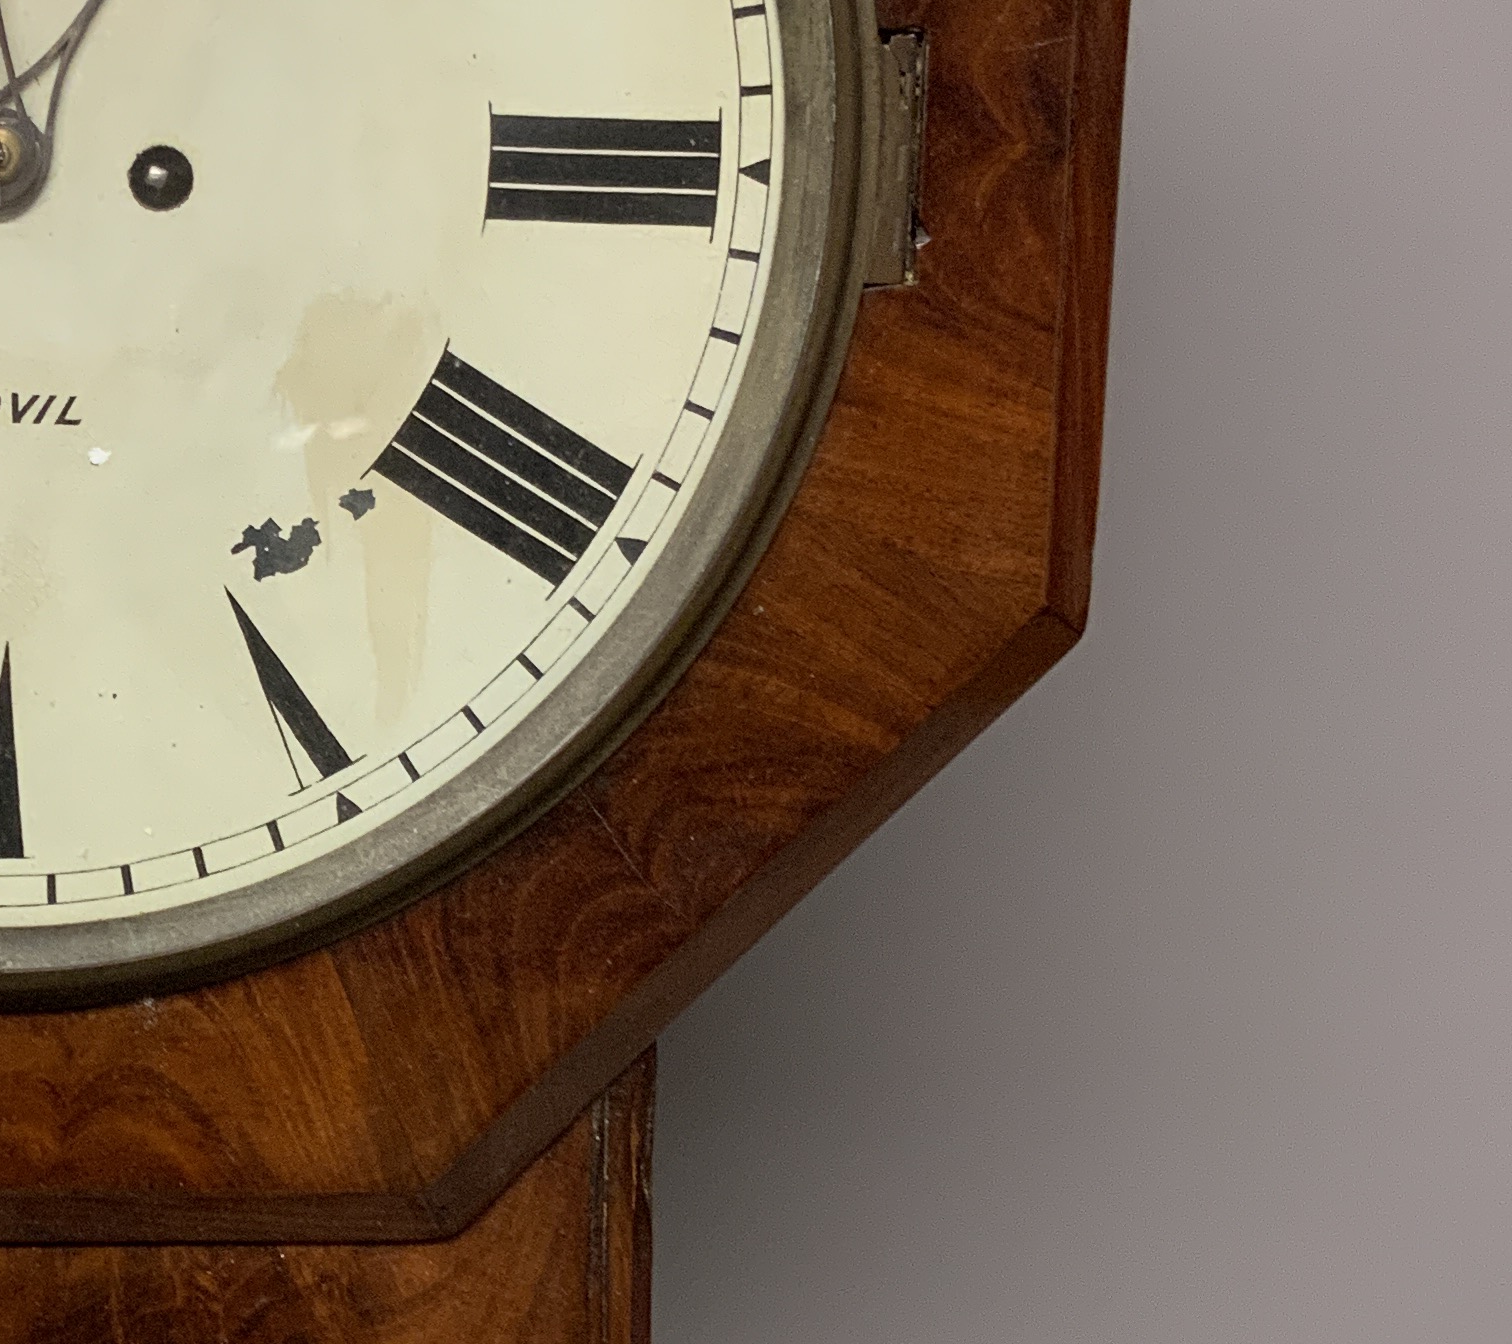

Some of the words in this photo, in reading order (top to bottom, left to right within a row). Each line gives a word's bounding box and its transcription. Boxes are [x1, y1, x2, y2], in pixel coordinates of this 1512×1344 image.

[482, 101, 722, 243] III
[361, 339, 644, 601] IIII
[224, 586, 367, 796] V
